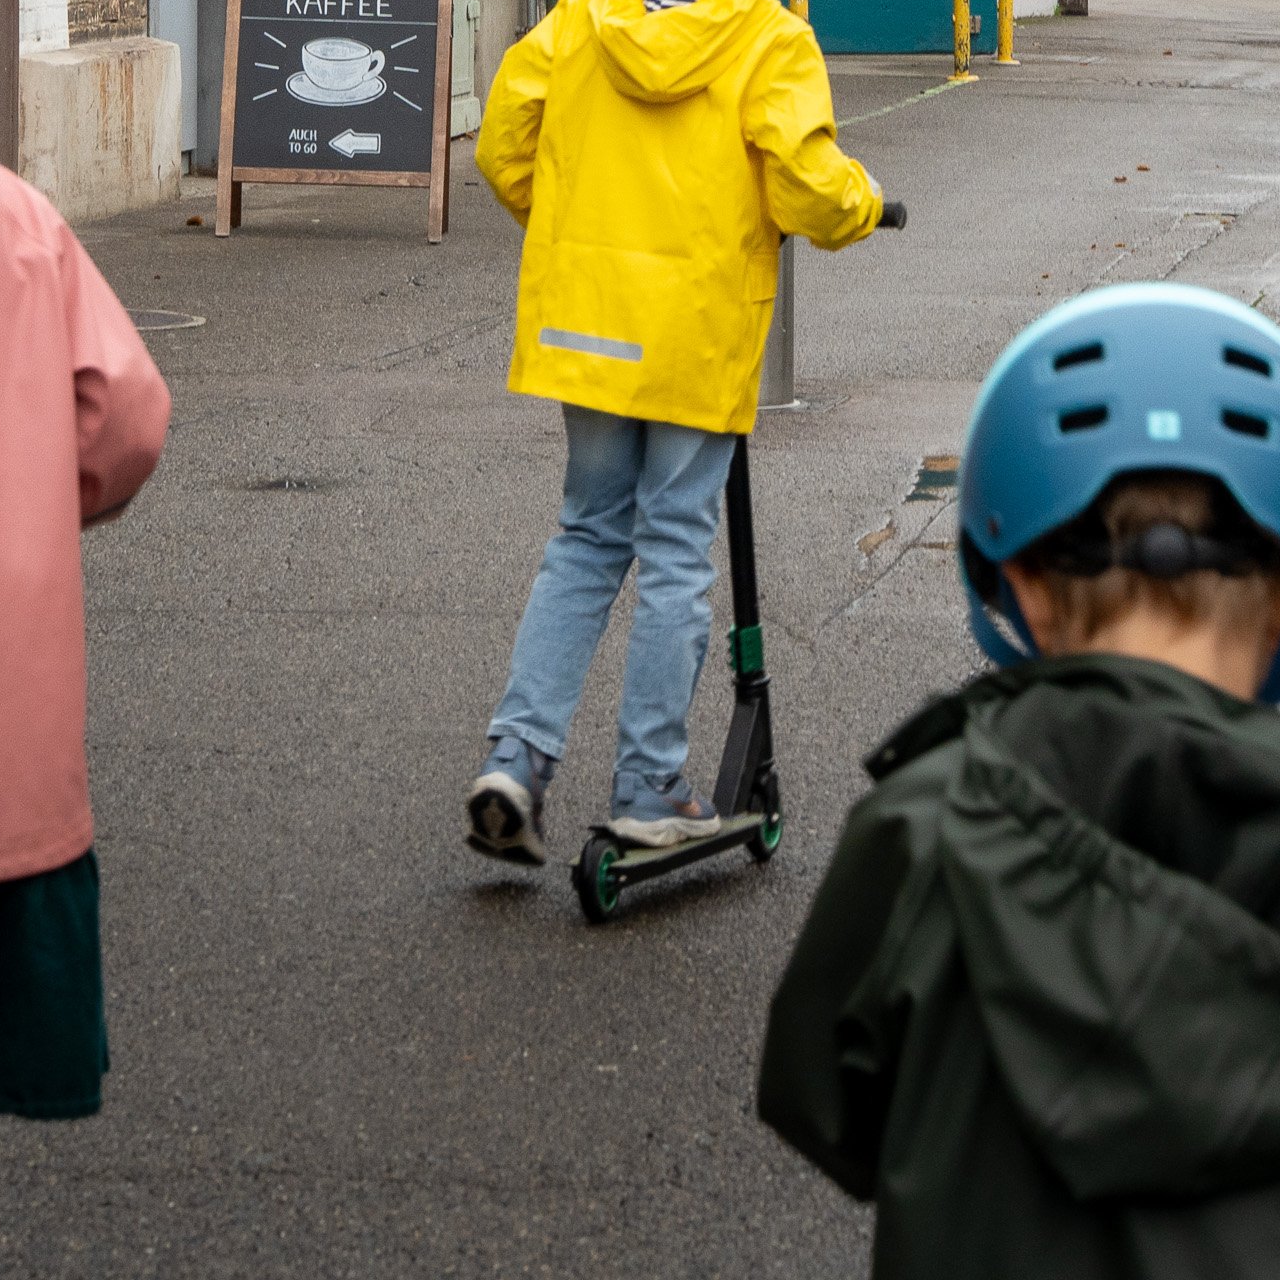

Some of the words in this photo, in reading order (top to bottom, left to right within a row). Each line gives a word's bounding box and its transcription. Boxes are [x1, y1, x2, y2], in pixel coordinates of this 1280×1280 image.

[288, 128, 318, 141] AUCH
[288, 142, 302, 154] TO
[303, 142, 318, 154] GO
